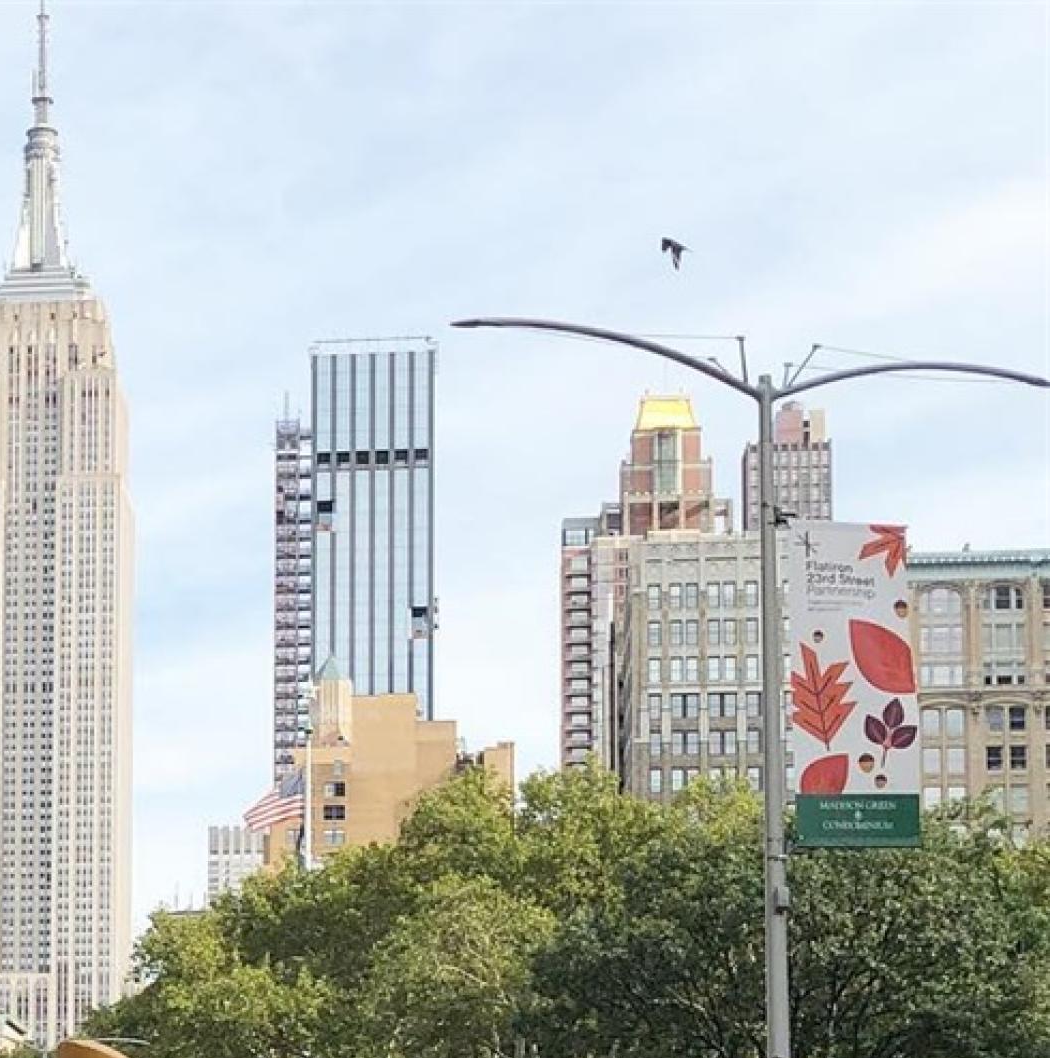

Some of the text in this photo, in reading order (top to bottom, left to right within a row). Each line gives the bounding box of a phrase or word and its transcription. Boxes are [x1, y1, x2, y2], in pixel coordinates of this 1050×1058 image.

[806, 561, 854, 572] Flatiron
[806, 572, 875, 587] 23rd Street
[806, 585, 876, 600] Partnership
